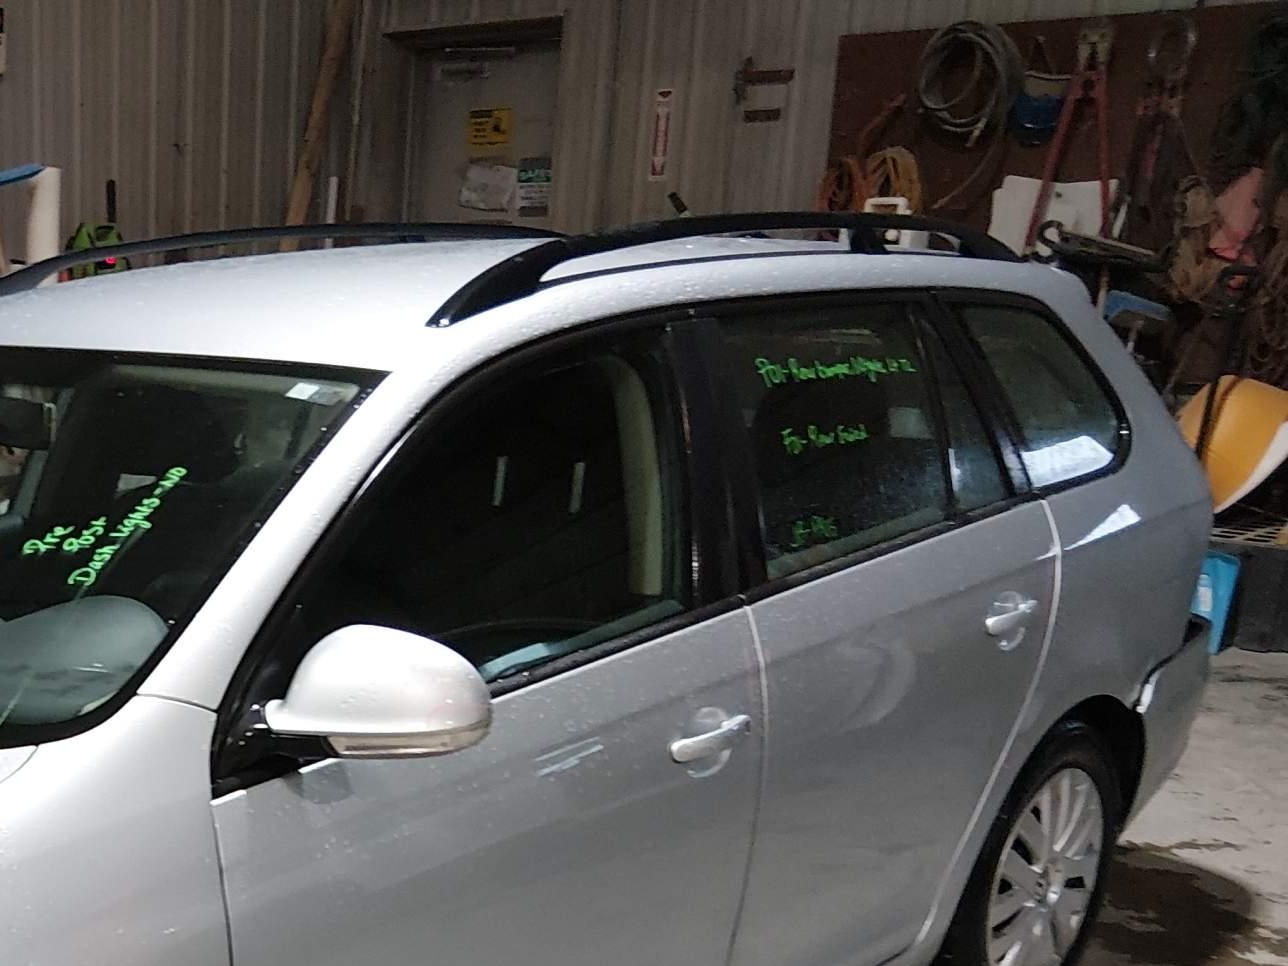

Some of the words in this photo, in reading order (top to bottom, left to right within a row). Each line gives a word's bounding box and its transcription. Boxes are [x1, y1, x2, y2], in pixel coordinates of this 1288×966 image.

[22, 525, 76, 556] Pre
[62, 515, 108, 553] Post
[67, 543, 122, 587] Dash
